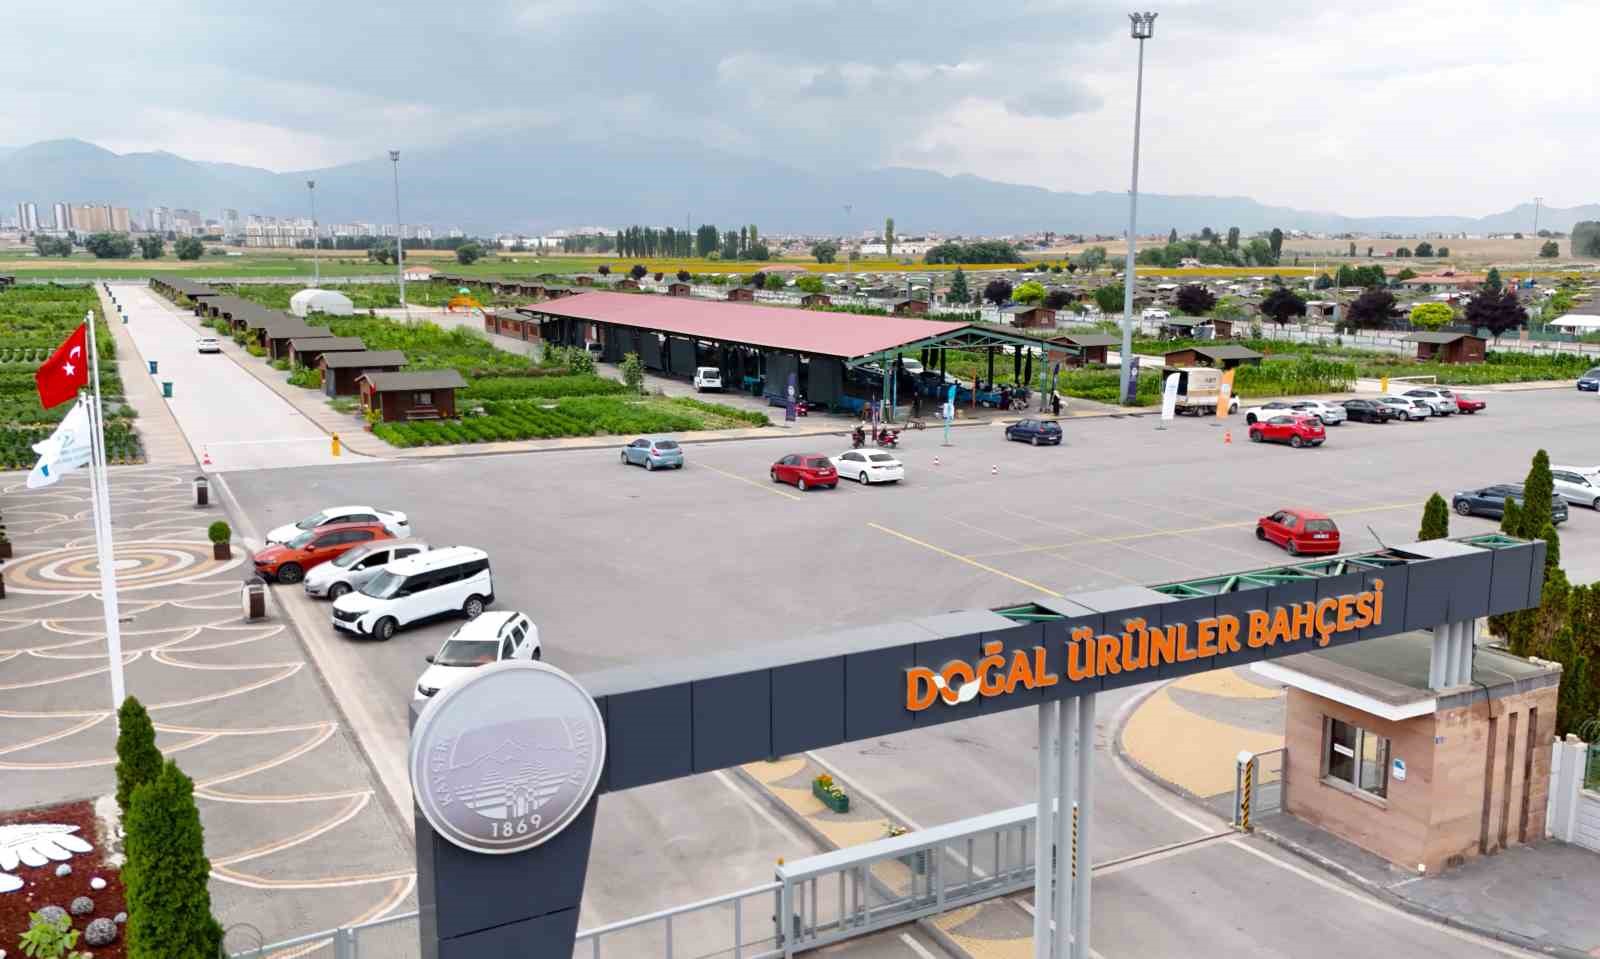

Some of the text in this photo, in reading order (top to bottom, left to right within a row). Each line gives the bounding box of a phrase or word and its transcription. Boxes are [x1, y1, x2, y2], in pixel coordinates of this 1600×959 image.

[905, 578, 1384, 712] DOĞAL ÜRÜNLER BAHÇESİ
[490, 813, 542, 838] 1869
